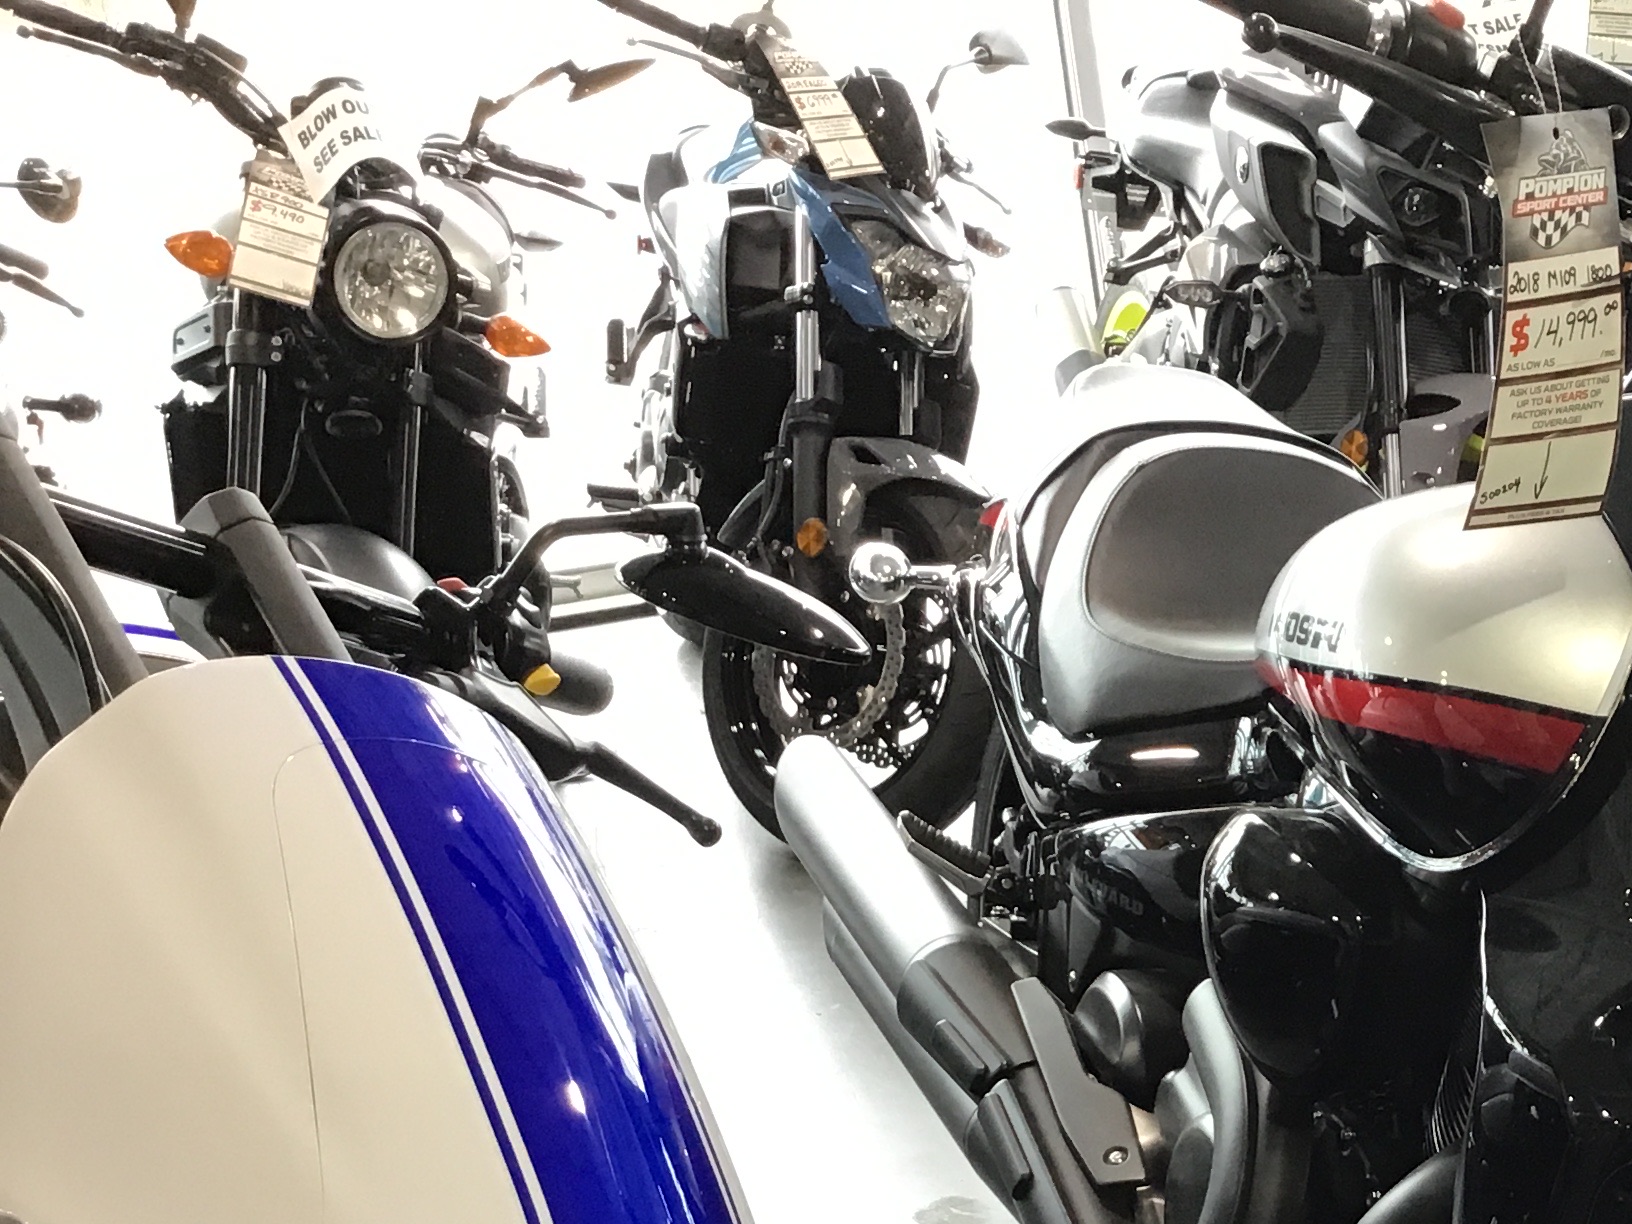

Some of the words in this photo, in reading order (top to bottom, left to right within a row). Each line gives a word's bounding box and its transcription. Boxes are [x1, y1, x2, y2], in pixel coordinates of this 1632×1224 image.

[297, 103, 338, 151] BLOW
[313, 138, 340, 174] SEE
[1518, 168, 1607, 201] POMPTON
[1516, 198, 1559, 213] SPORT
[1559, 190, 1605, 207] CENTER
[1509, 270, 1541, 296] 2018
[1547, 266, 1577, 288] M109
[1505, 362, 1520, 373] AS
[1520, 360, 1541, 371] LOW
[1542, 357, 1556, 368] AS
[1509, 387, 1528, 398] ASK
[1529, 385, 1542, 395] US
[1543, 380, 1573, 394] ABOUT
[1574, 374, 1611, 389] GETTING
[1516, 399, 1530, 409] UP
[1531, 397, 1544, 407] TO
[1545, 394, 1552, 405] 4
[1554, 388, 1589, 404] YEARS
[1589, 387, 1603, 399] OF
[1511, 407, 1554, 421] FACTORY
[1555, 399, 1605, 415] WARRANTY
